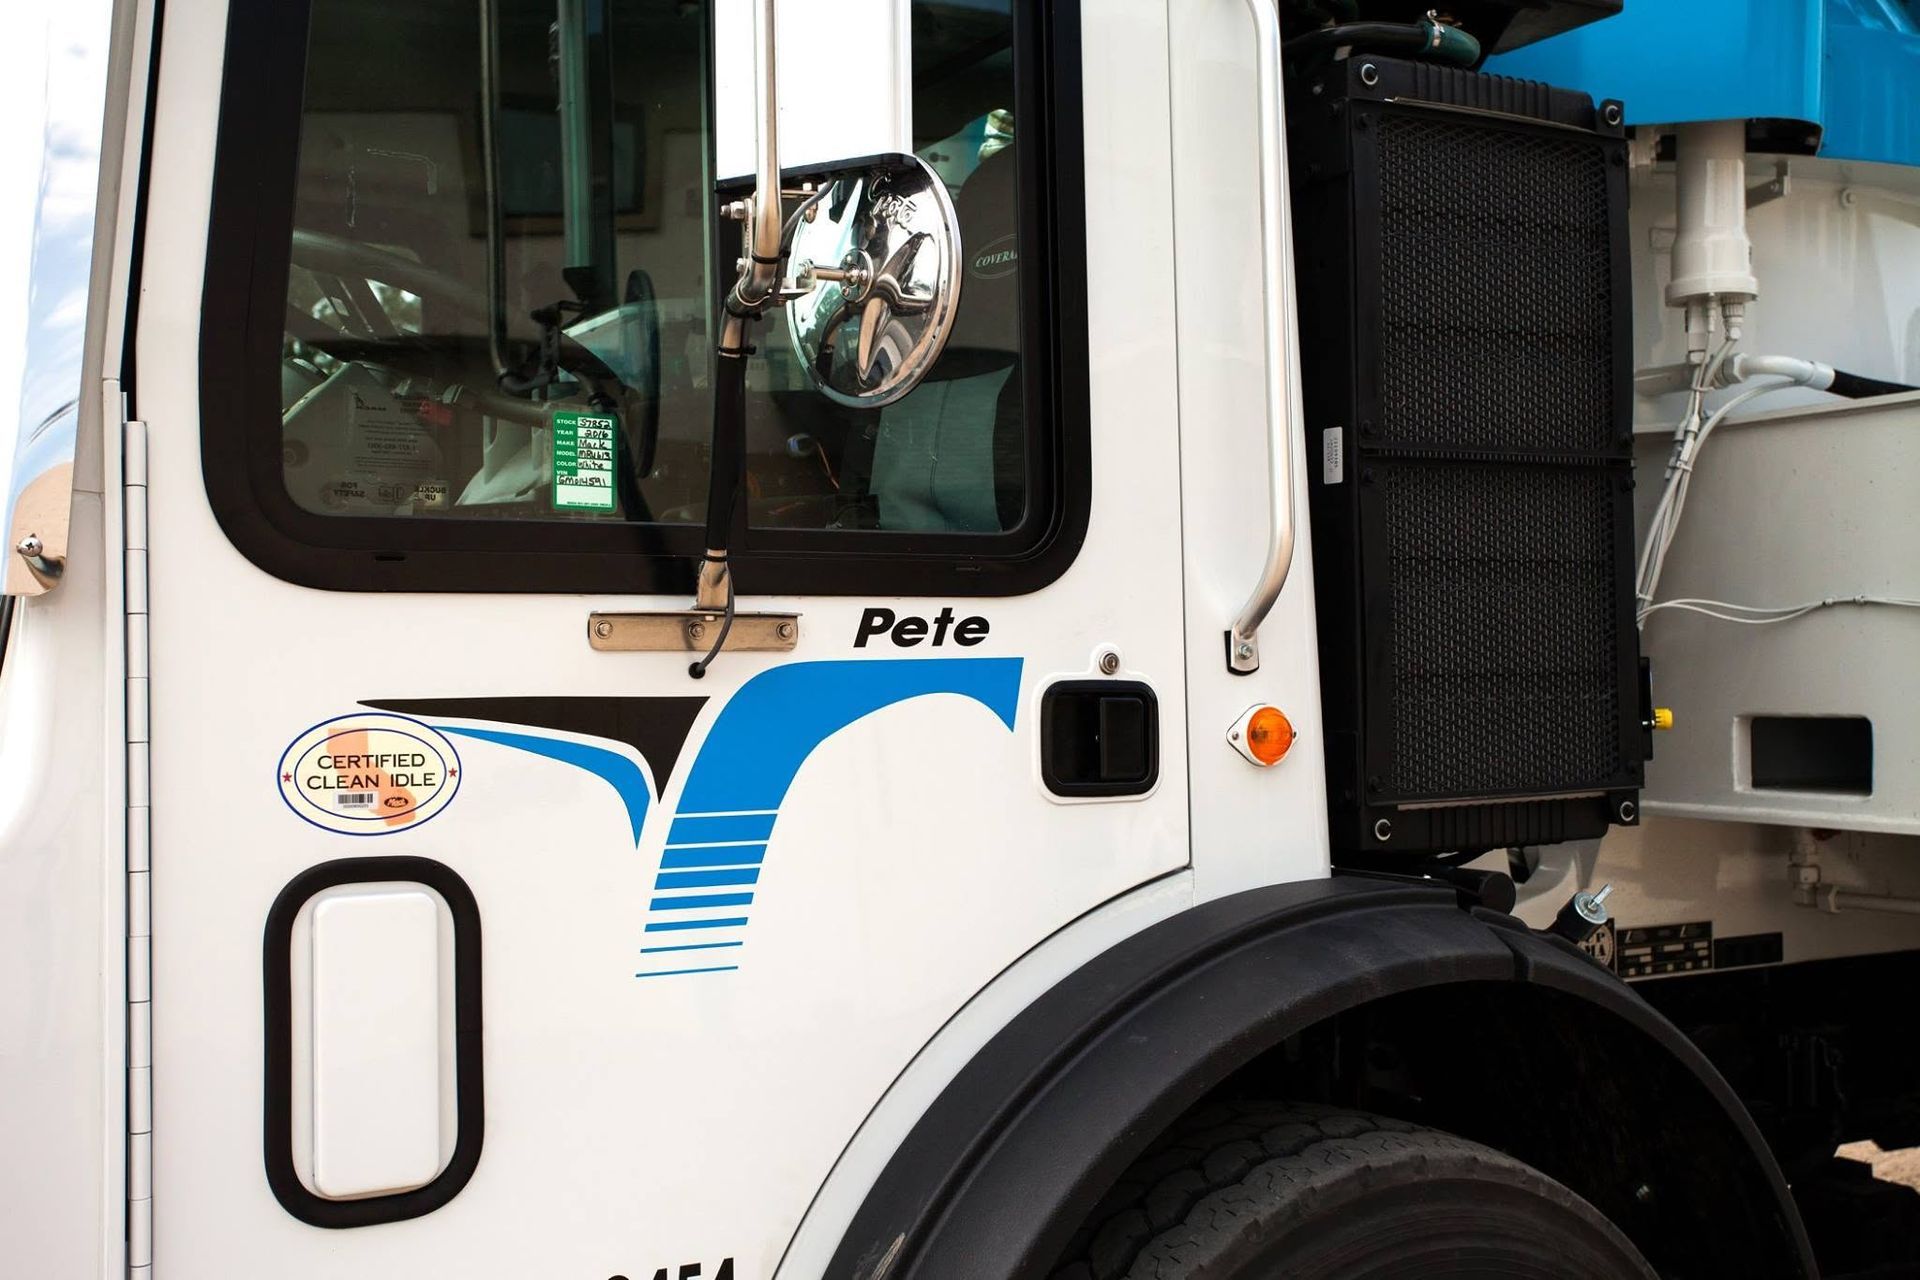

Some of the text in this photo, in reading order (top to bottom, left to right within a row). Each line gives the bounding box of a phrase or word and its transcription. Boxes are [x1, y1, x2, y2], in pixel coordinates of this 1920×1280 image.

[585, 429, 609, 438] 2016
[853, 607, 990, 648] Pete
[317, 753, 425, 769] CERTIFIED
[307, 772, 436, 790] CLEAN IDLE
